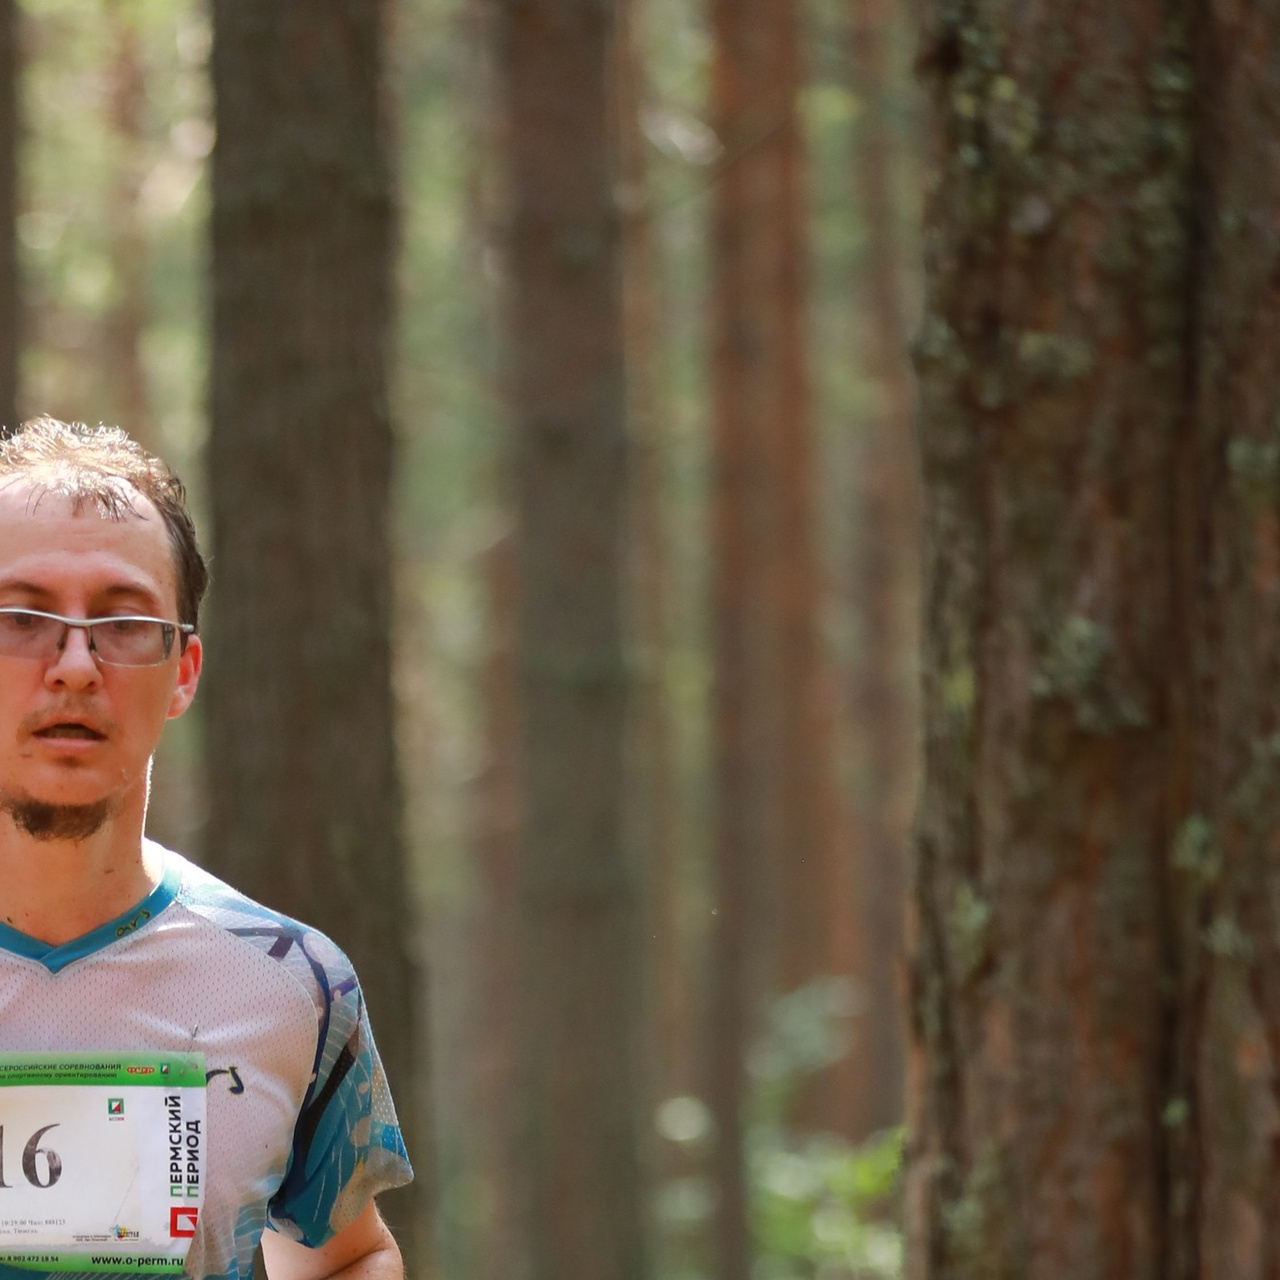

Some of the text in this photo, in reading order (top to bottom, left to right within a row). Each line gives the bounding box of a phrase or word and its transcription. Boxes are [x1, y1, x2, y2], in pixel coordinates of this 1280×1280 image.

[59, 1063, 122, 1071] СОРЕВНОВАНИЯ
[165, 1095, 183, 1198] ПЕРМСКИЙ
[186, 1119, 202, 1198] ПЕРИОД
[91, 1256, 184, 1267] www.o-perm.ru
